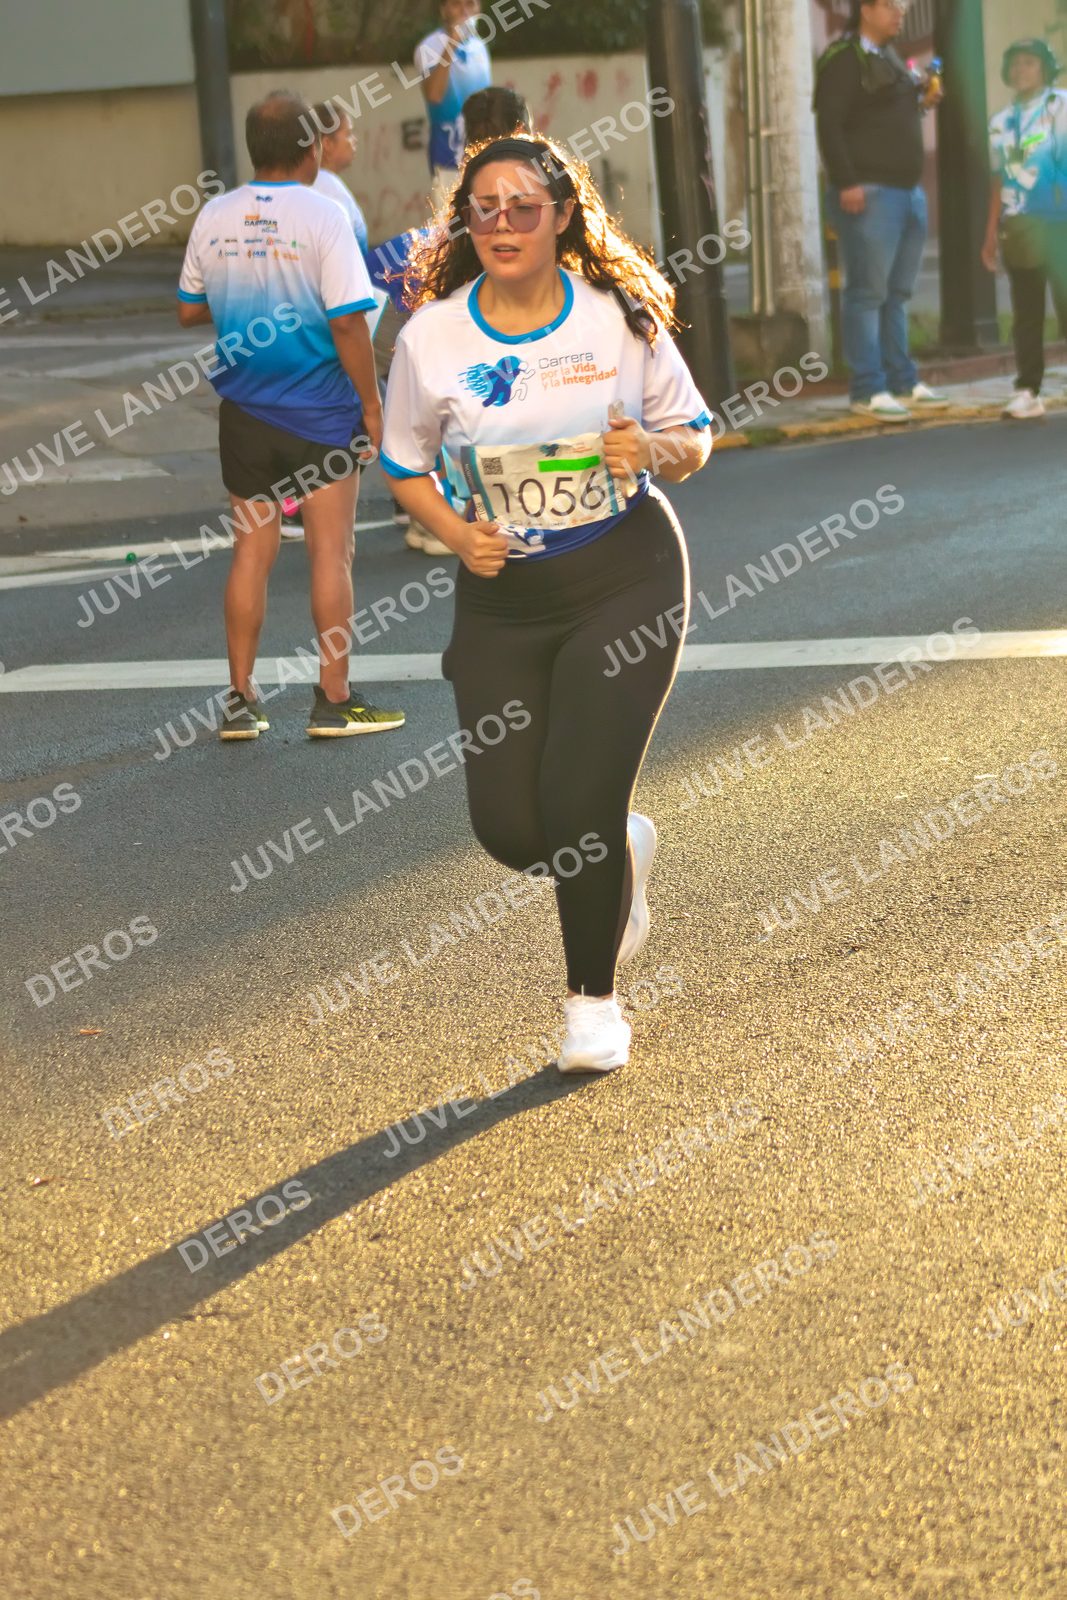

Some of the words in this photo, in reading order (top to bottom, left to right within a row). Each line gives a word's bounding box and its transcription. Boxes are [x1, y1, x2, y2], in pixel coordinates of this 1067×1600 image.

[538, 352, 594, 370] Carrera
[541, 368, 561, 381] por
[561, 364, 572, 375] la
[572, 363, 597, 374] Vida
[541, 382, 549, 391] y
[550, 376, 560, 387] la
[562, 367, 618, 386] Integridad
[492, 471, 606, 518] 1056
